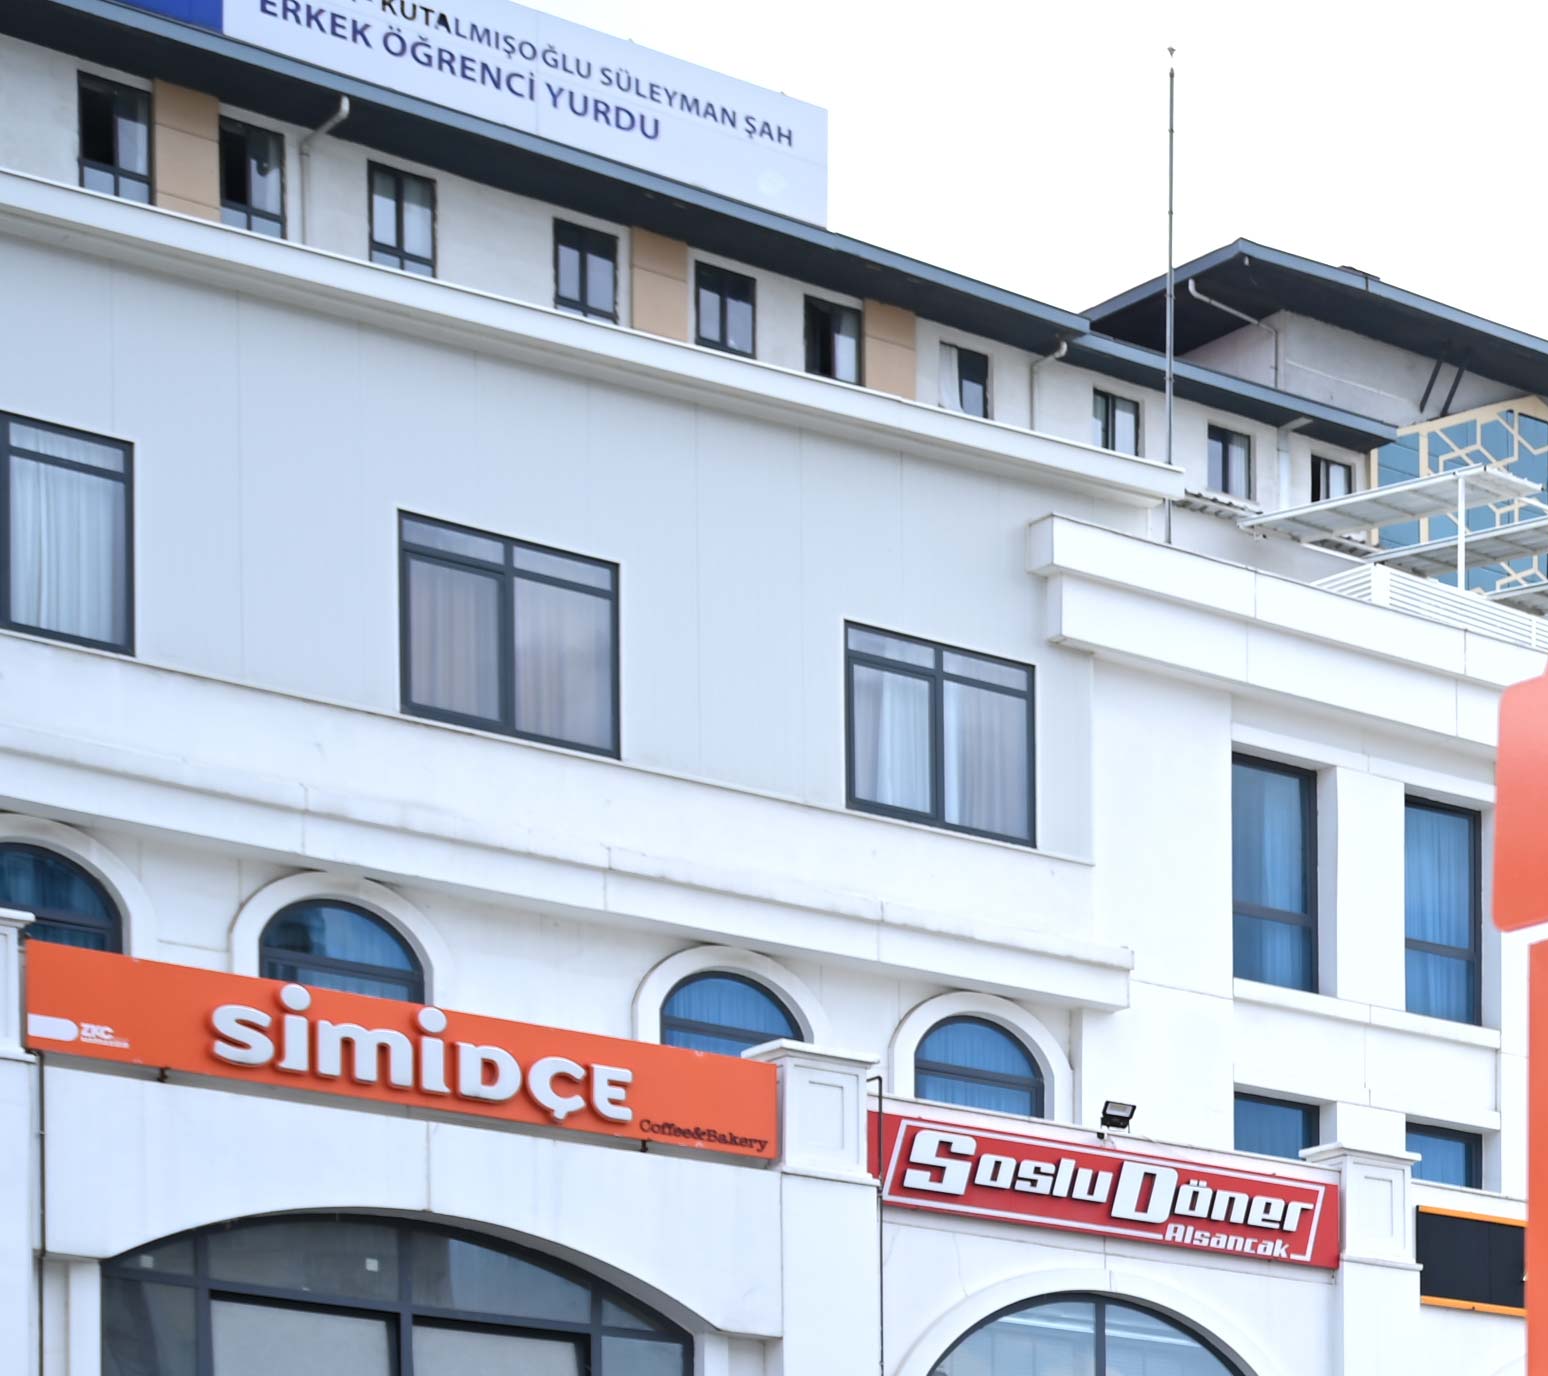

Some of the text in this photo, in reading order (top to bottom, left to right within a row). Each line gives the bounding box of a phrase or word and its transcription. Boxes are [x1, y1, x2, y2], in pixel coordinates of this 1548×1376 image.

[260, 0, 661, 140] ERKEK ÖĞRENCİ YURDU
[599, 66, 737, 128] SÜLEYMAN
[744, 115, 793, 147] ŞAH
[639, 1118, 769, 1153] Coffee&Bakery
[903, 1130, 1314, 1232] Soslu Döner
[1164, 1223, 1291, 1258] Alsancak
